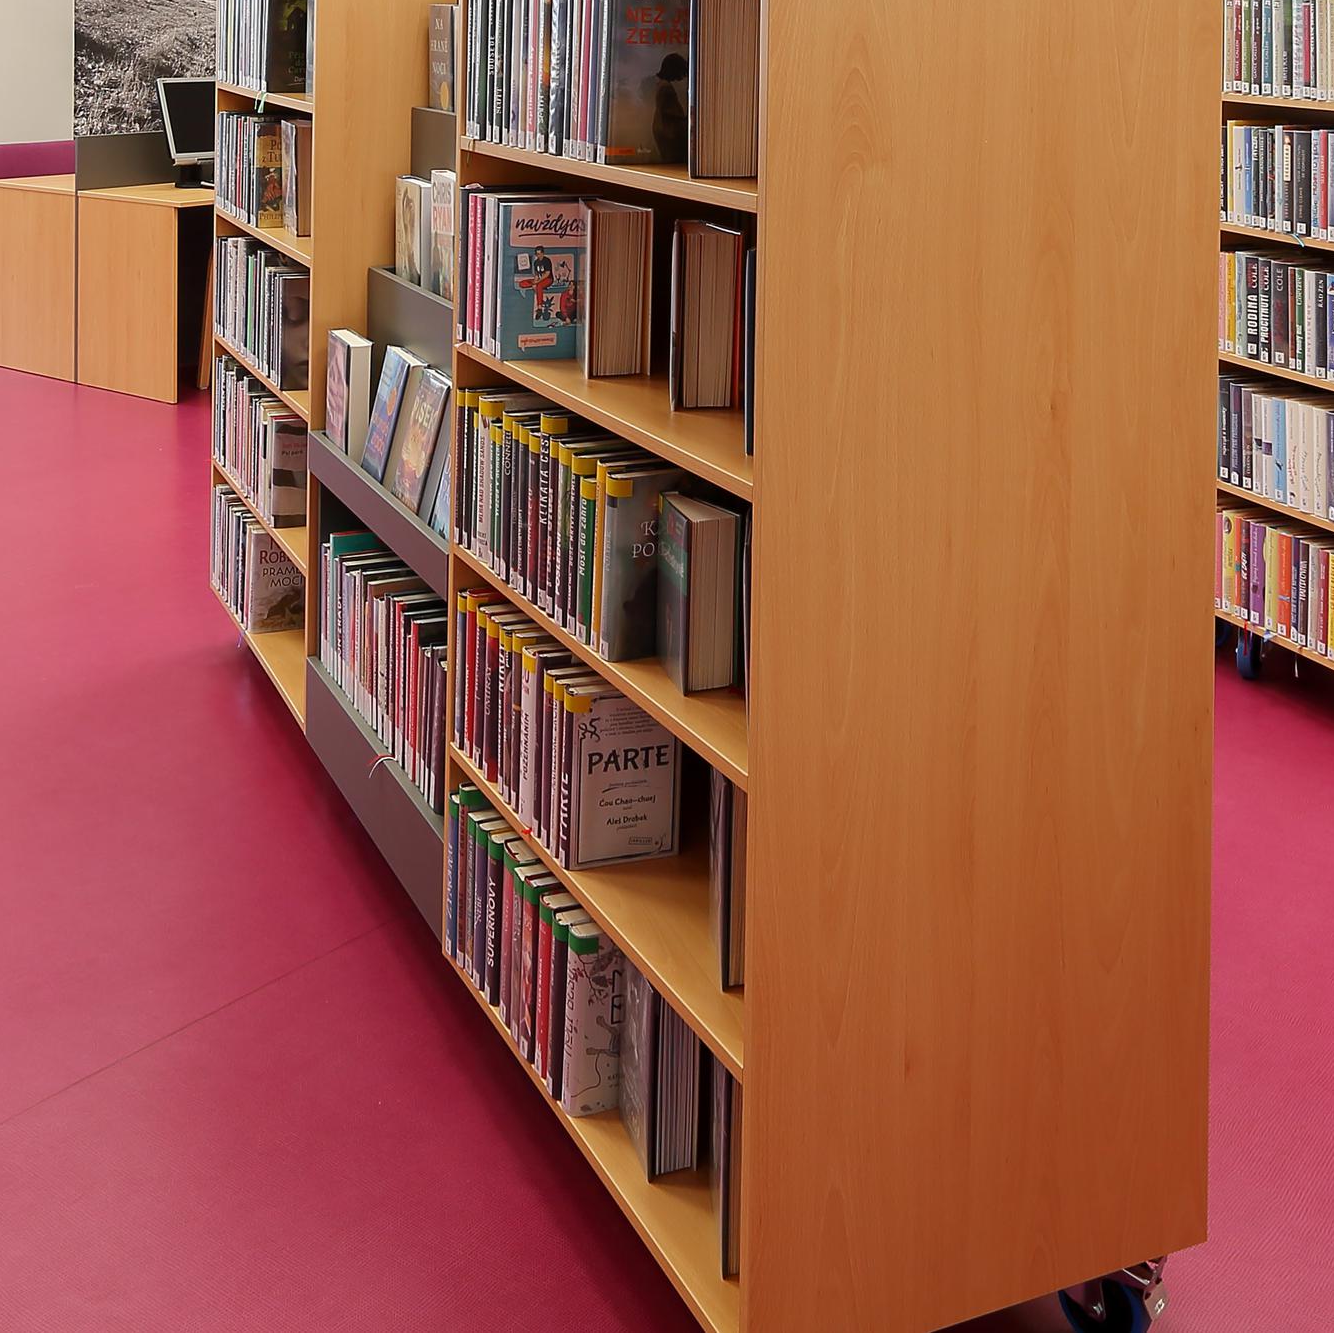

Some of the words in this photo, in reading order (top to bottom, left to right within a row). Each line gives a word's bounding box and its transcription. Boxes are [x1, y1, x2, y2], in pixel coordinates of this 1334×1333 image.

[625, 4, 665, 24] NEŽ
[432, 207, 452, 233] RYAN
[1275, 268, 1283, 291] COLE
[1247, 294, 1257, 335] RODINA
[1260, 294, 1269, 343] PROCITNUTÍ
[632, 543, 658, 559] PO
[263, 567, 301, 577] PRAME
[587, 744, 670, 775] PARTE
[487, 877, 497, 967] SUPERNOVY
